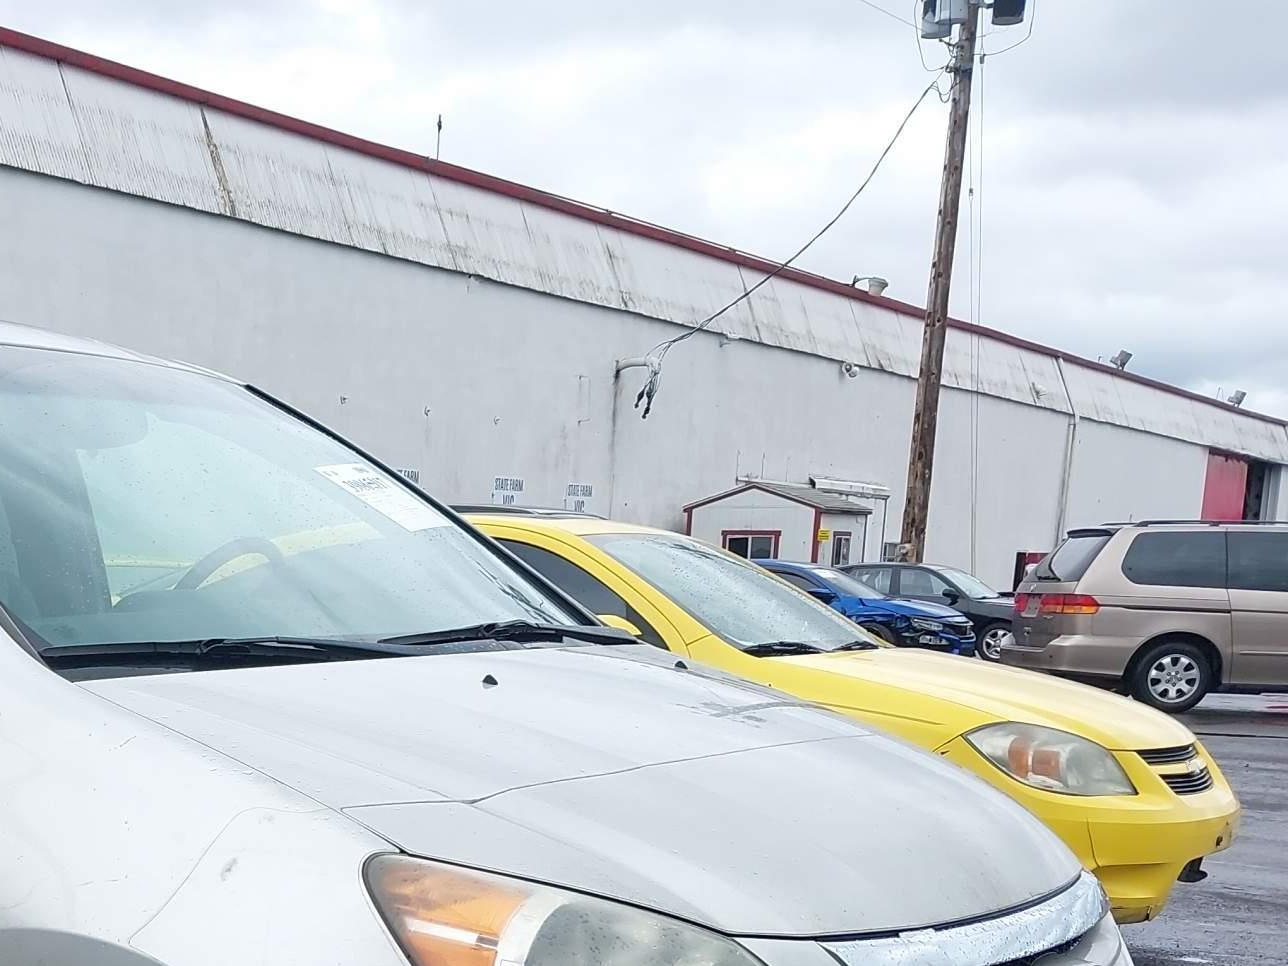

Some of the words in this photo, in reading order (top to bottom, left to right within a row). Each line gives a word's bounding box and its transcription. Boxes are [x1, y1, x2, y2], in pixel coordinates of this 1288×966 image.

[495, 477, 509, 491] STATE
[510, 478, 524, 492] FARM
[568, 484, 579, 497] STATE
[580, 484, 593, 498] FARM
